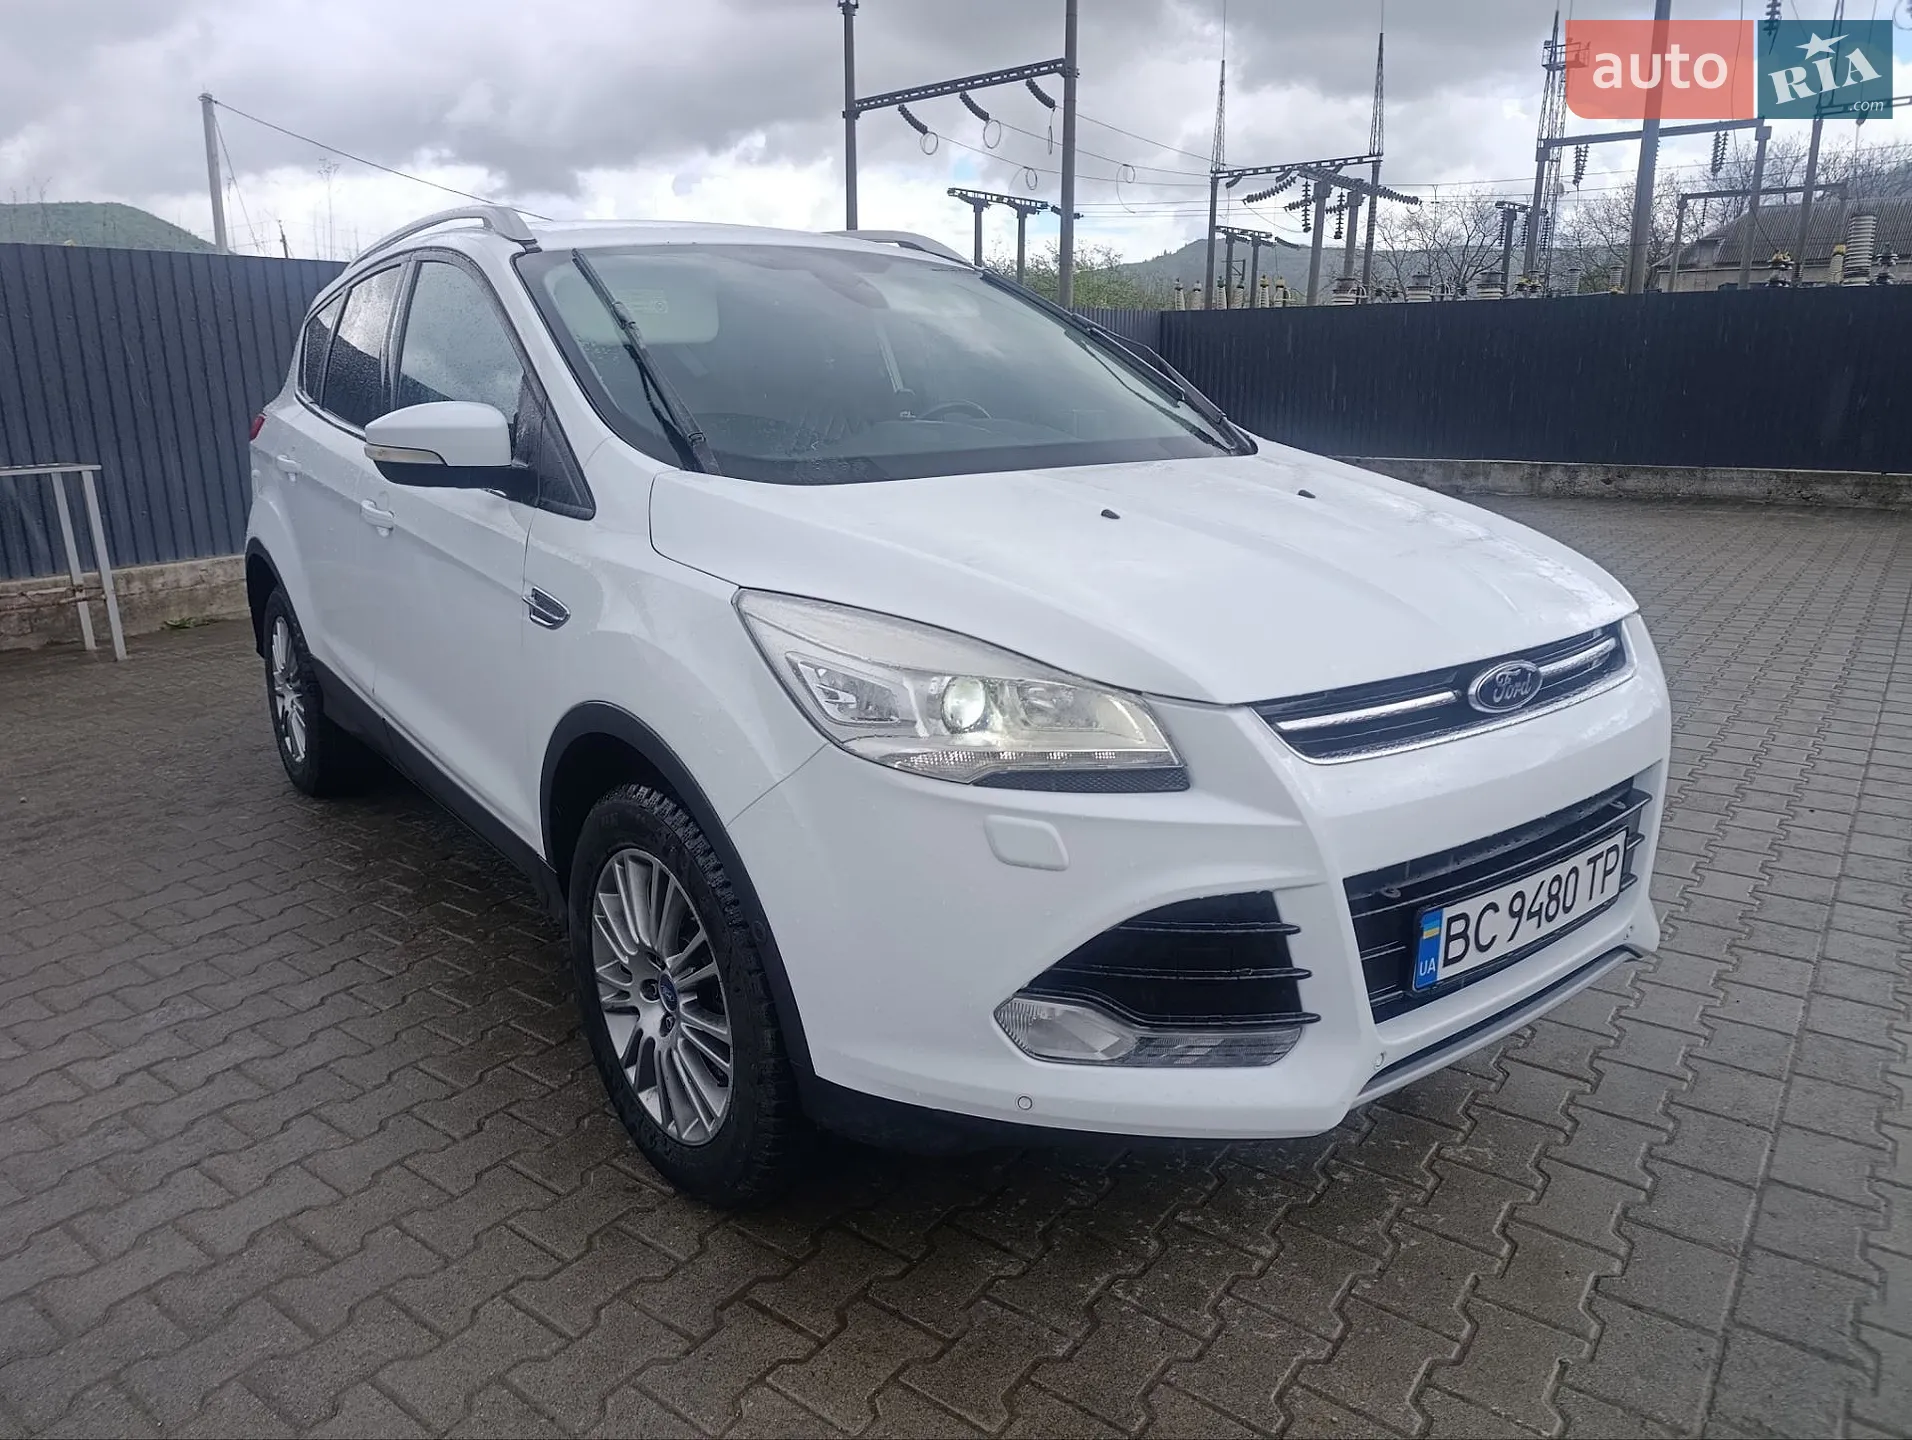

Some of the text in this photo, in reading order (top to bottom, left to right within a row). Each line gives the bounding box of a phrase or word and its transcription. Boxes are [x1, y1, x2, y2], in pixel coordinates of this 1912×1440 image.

[1493, 668, 1532, 702] Ford
[1443, 844, 1620, 968] BC 9480 TP
[1419, 957, 1436, 977] UA
